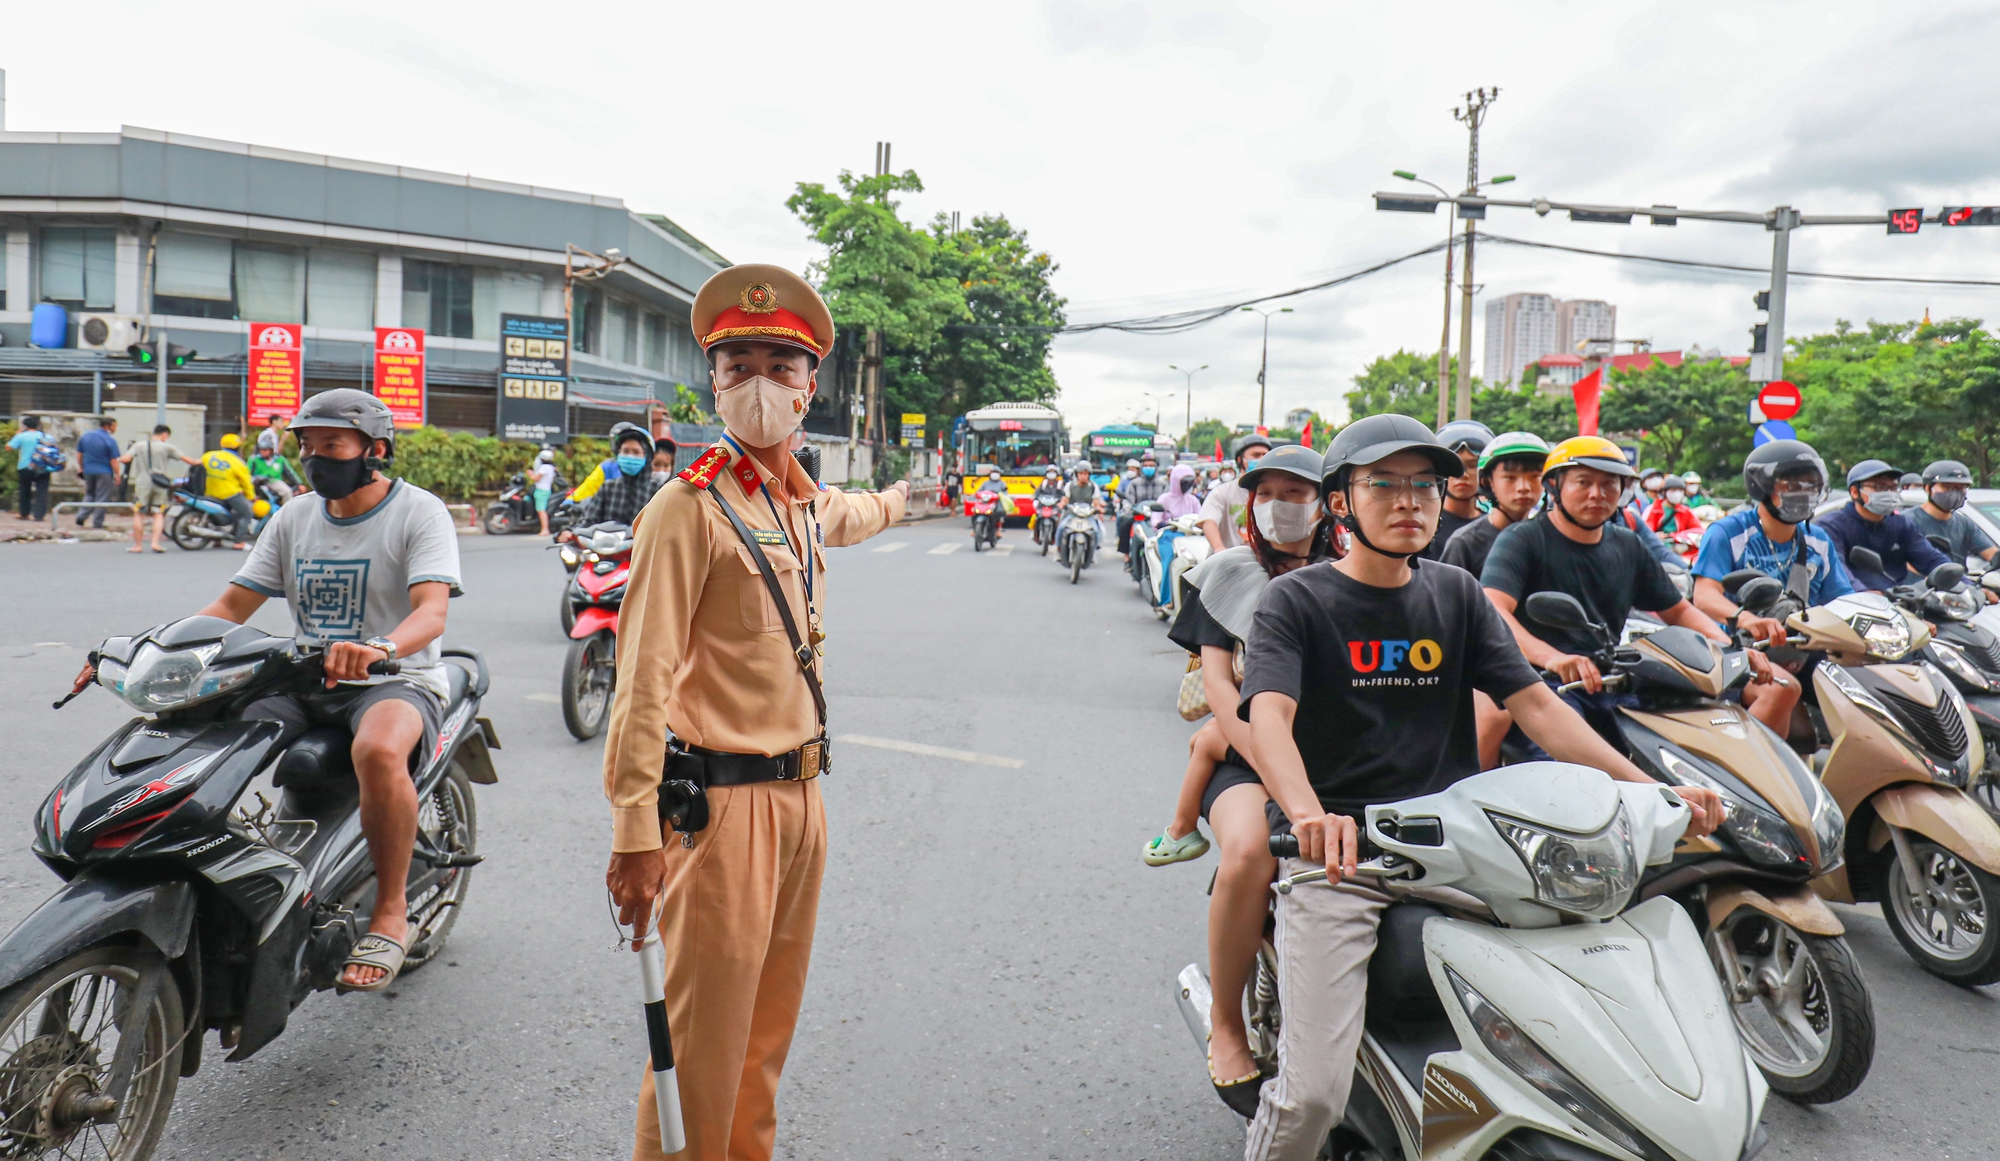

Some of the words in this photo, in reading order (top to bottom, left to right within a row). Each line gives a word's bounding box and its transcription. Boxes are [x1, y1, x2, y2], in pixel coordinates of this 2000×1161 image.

[1892, 209, 1919, 233] 45
[1347, 639, 1443, 673] UFO
[1710, 717, 1740, 726] HON
[186, 833, 233, 857] HONDA
[1581, 943, 1631, 955] HONDA
[1430, 1066, 1479, 1115] HONDA
